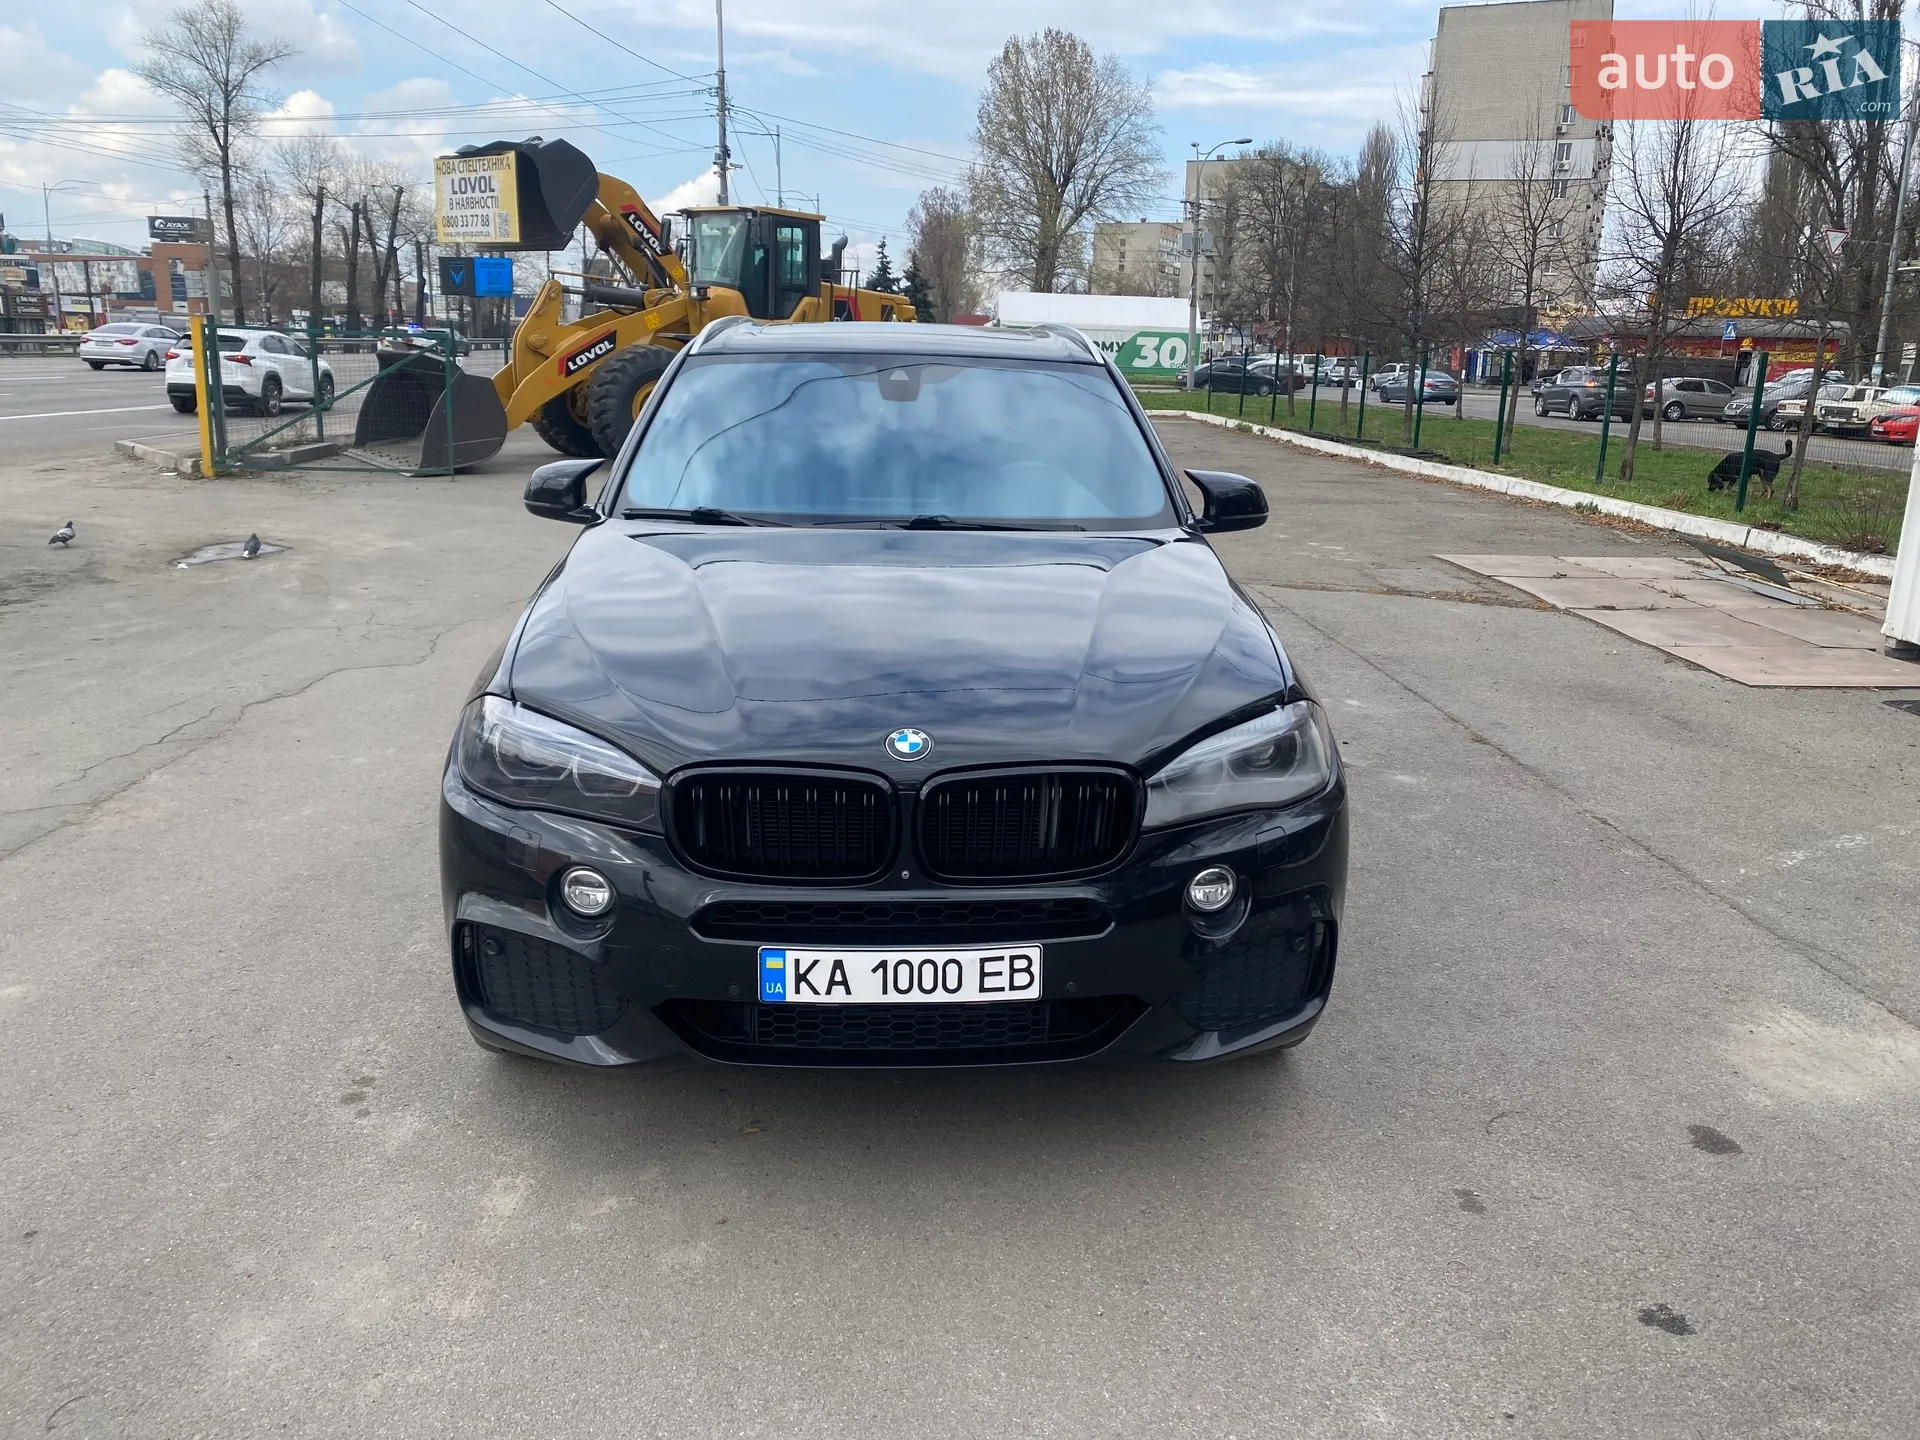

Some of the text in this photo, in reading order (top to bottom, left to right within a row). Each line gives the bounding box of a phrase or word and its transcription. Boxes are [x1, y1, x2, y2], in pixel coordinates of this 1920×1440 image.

[436, 156, 511, 175] НОВА СПЕЦТЕХНІКА
[451, 176, 496, 195] LOVOL
[449, 196, 500, 210] В НАЯВНОСТІ!
[442, 213, 490, 228] 0800 33 77 88
[628, 213, 662, 255] LOVOL
[1687, 296, 1799, 317] ПРОДУКТИ
[567, 340, 615, 371] LOVOL
[1131, 336, 1187, 368] 30
[890, 729, 928, 739] BMW
[793, 953, 1035, 996] KA 1000 EB
[766, 982, 783, 994] UA
